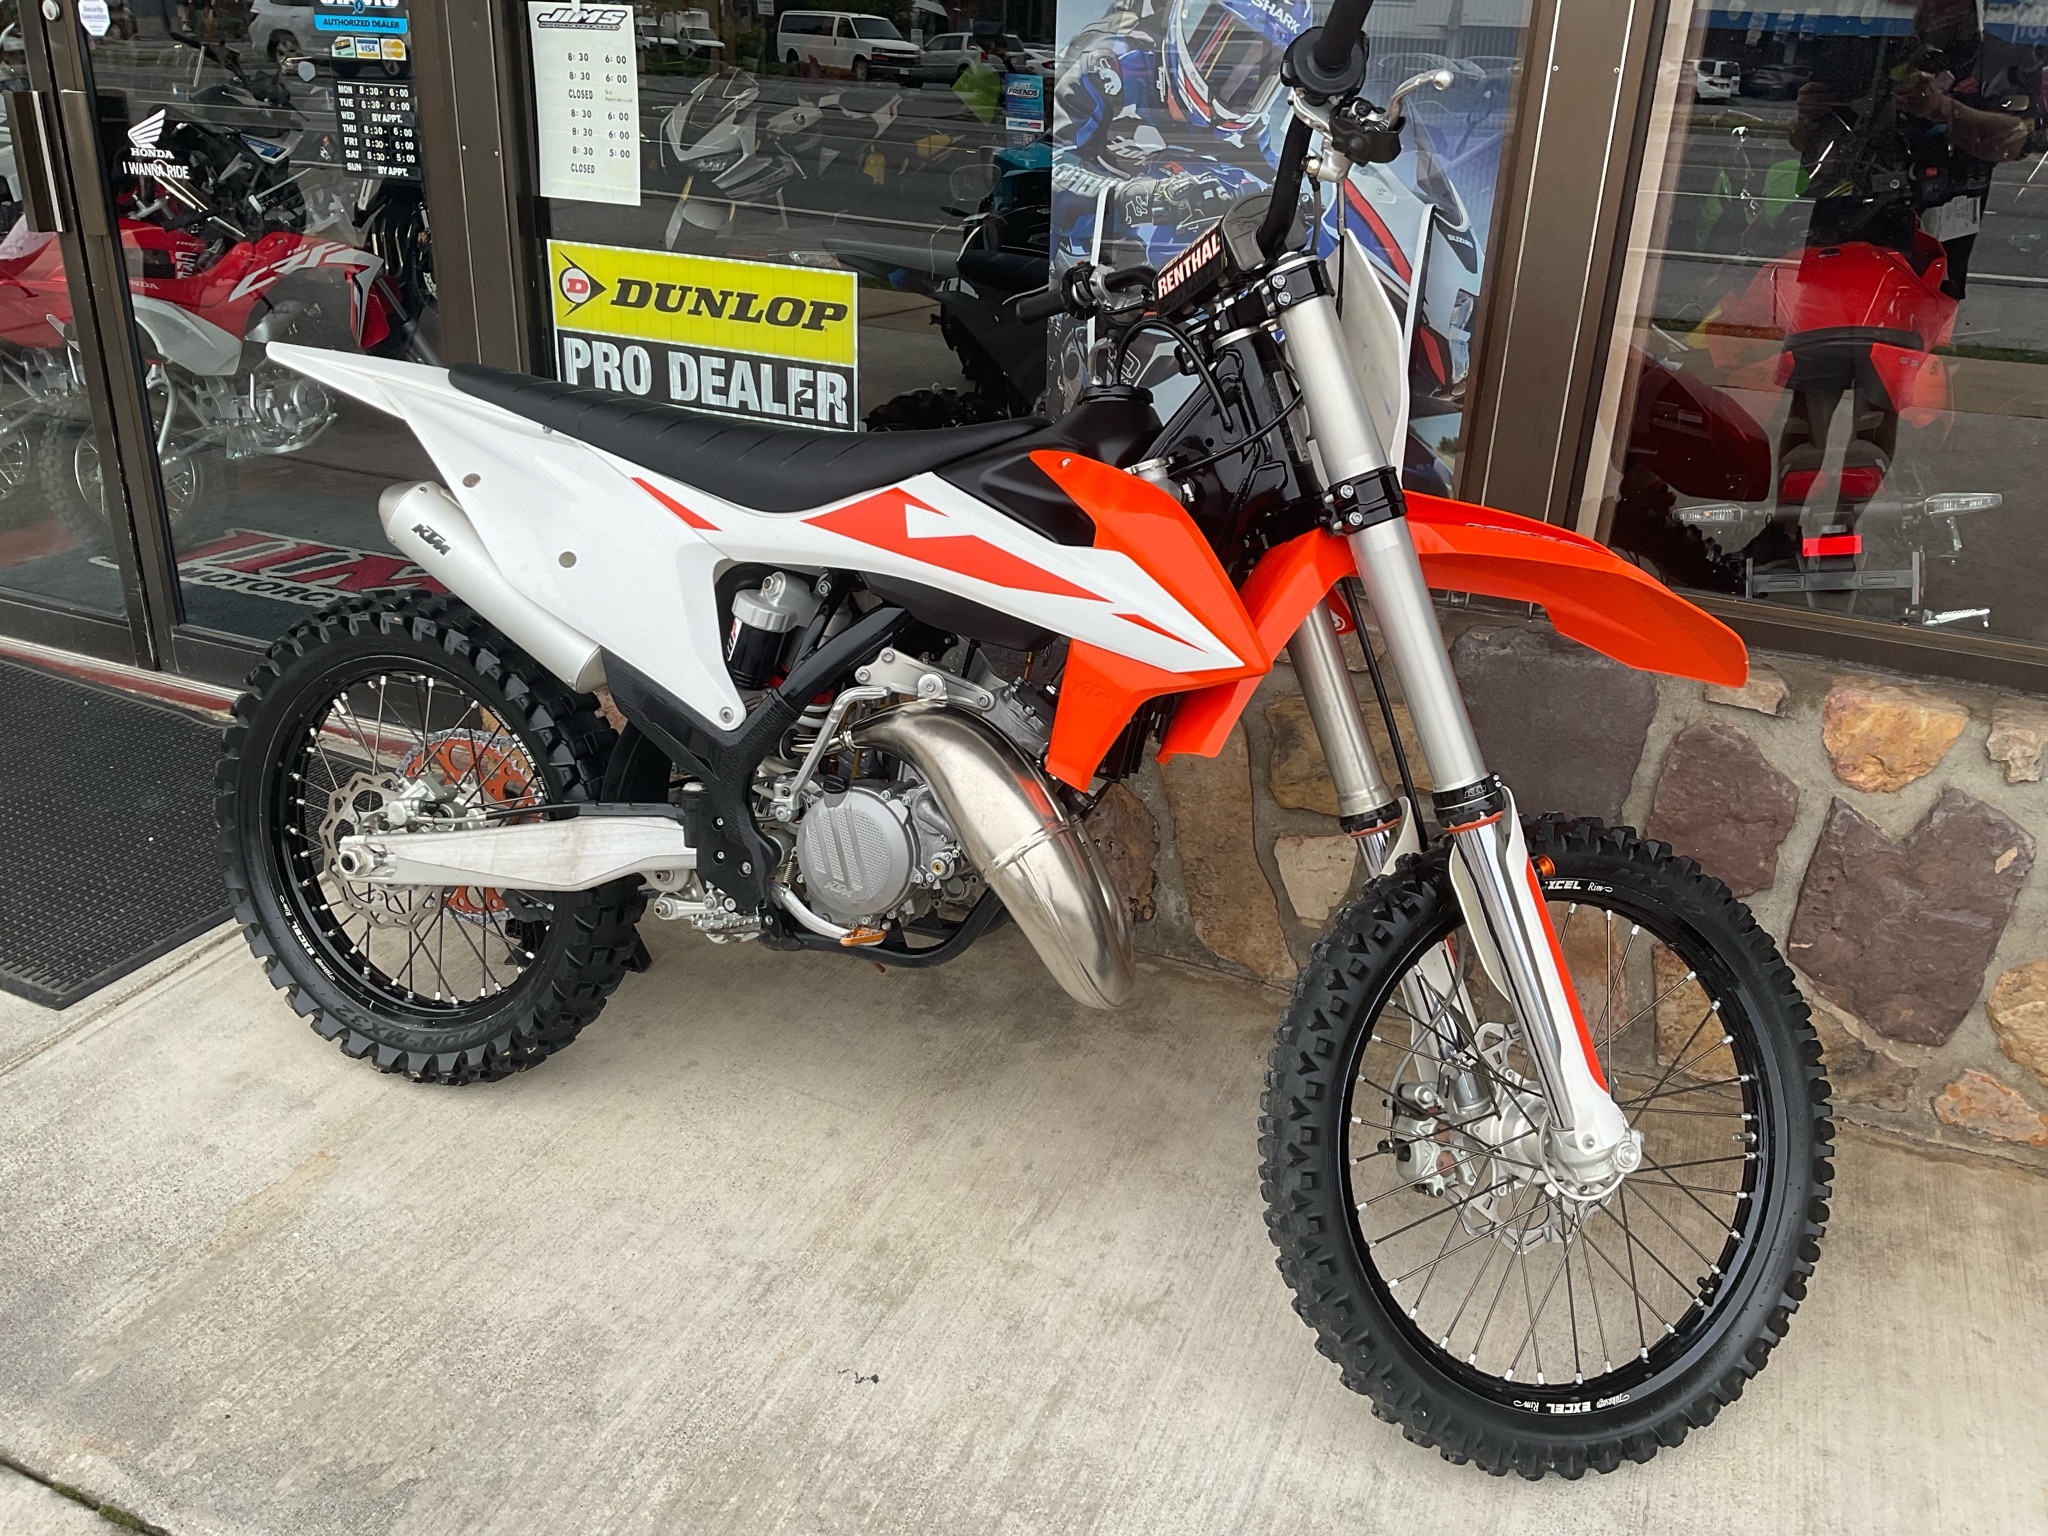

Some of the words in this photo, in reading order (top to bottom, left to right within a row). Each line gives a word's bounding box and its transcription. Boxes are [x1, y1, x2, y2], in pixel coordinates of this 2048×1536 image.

[323, 18, 370, 27] AUTHORIZED
[372, 20, 399, 28] DEALER
[537, 8, 627, 25] JIMS
[1251, 0, 1302, 34] SHARK
[338, 85, 353, 94] MON
[389, 88, 409, 97] 6:00
[568, 89, 593, 100] CLOSED
[1007, 87, 1039, 97] FRIENDS
[339, 98, 354, 107] TUE
[390, 102, 410, 111] 6:00
[340, 111, 355, 120] WED
[371, 113, 381, 121] BY
[342, 124, 357, 133] THU
[393, 127, 413, 137] 6:00
[344, 137, 358, 146] FRI
[395, 141, 414, 150] 6:00
[130, 148, 175, 159] HONDA
[345, 149, 359, 159] SAT
[396, 153, 415, 163] 5:00
[122, 161, 127, 174] I
[128, 162, 166, 177] WANNA
[167, 164, 190, 179] RIDE
[346, 162, 362, 171] SUN
[377, 166, 387, 174] BY
[570, 163, 595, 174] CLOSED
[1157, 232, 1221, 300] RENTHAL
[129, 280, 159, 289] NDA
[566, 277, 589, 294] D
[610, 278, 848, 331] DUNLOP
[563, 337, 652, 395] PRO
[668, 351, 849, 425] DEALER
[411, 523, 451, 556] KTM
[511, 733, 536, 771] EXCEL
[1545, 880, 1581, 890] XCEL
[1587, 881, 1613, 893] Rim
[291, 920, 315, 956] EXCEL
[1513, 1400, 1539, 1412] Rim
[1546, 1401, 1592, 1414] EXCEL
